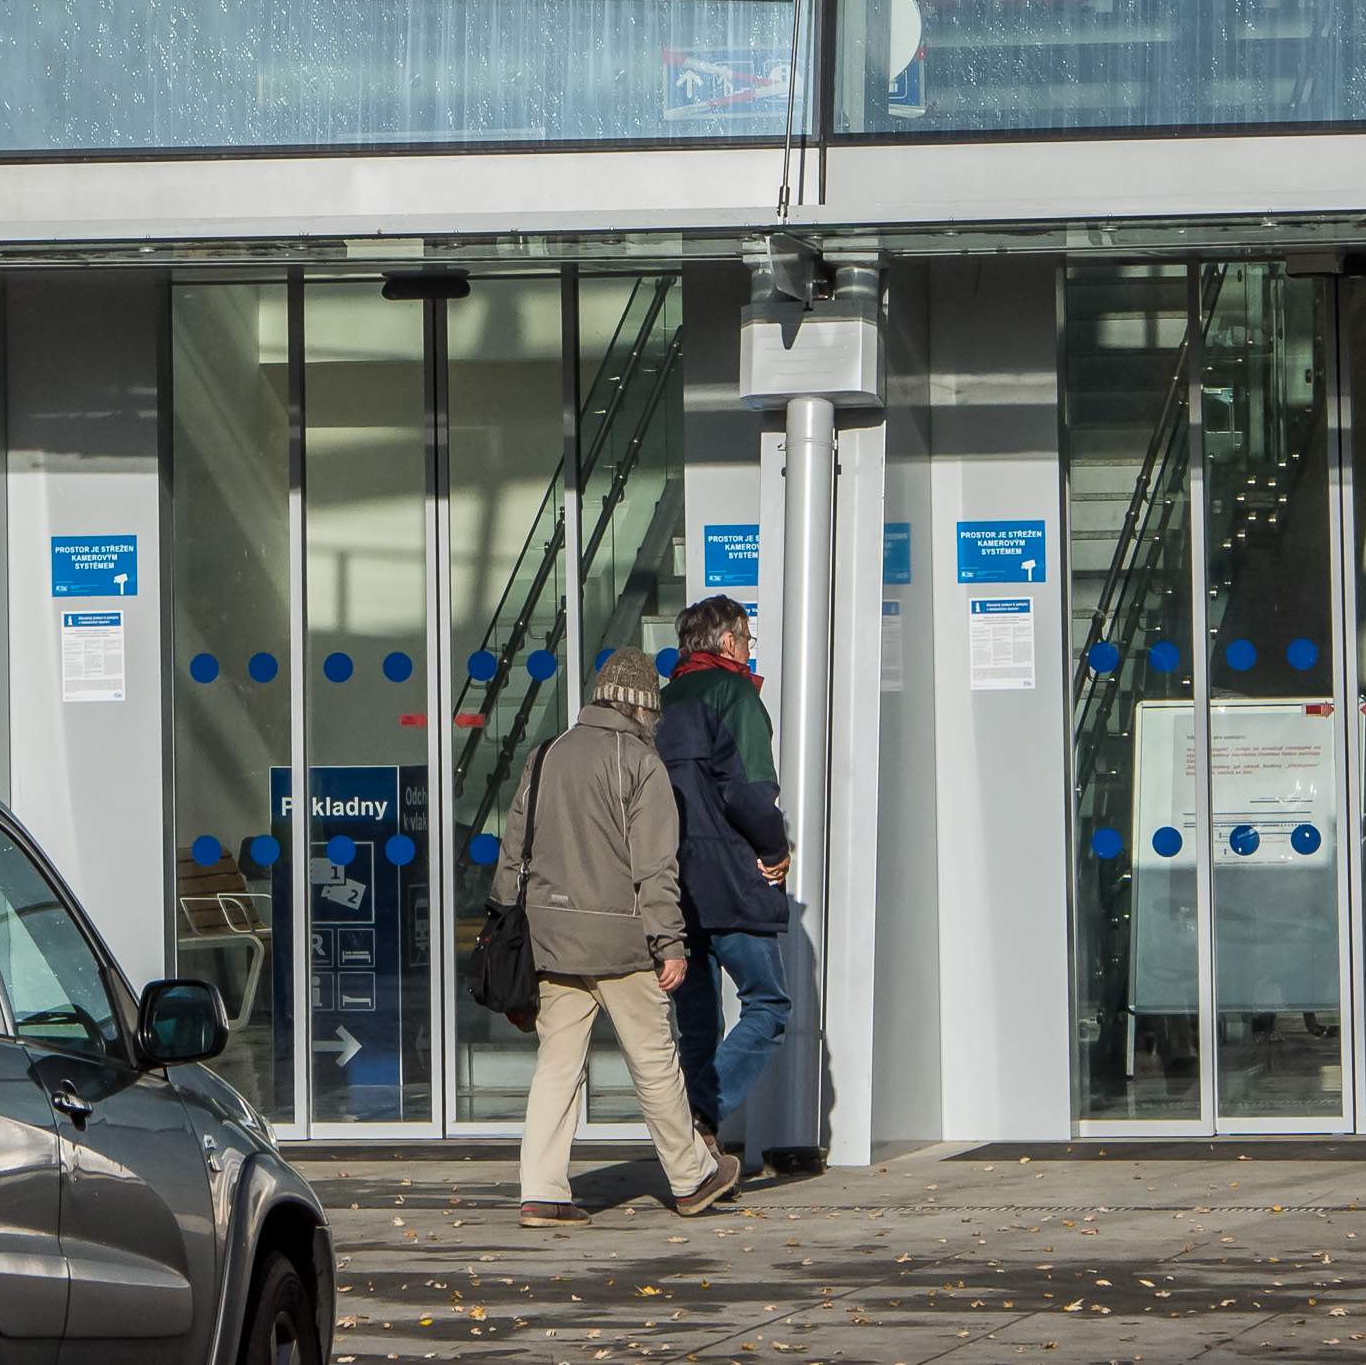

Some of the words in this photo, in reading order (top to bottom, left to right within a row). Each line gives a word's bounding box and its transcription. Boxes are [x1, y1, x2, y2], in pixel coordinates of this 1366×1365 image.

[960, 531, 996, 539] PROSTOR
[1008, 529, 1042, 538] STŘEŽEN
[708, 535, 743, 543] PROSTOR
[977, 539, 1026, 547] KAMEROVÝM
[101, 544, 134, 553] STŘEŽEN
[981, 547, 1022, 555] SYSTÉMEM
[71, 552, 118, 561] KAMEROVÝM
[74, 561, 115, 570] SYSTÉMEM
[281, 796, 388, 821] Pkladny
